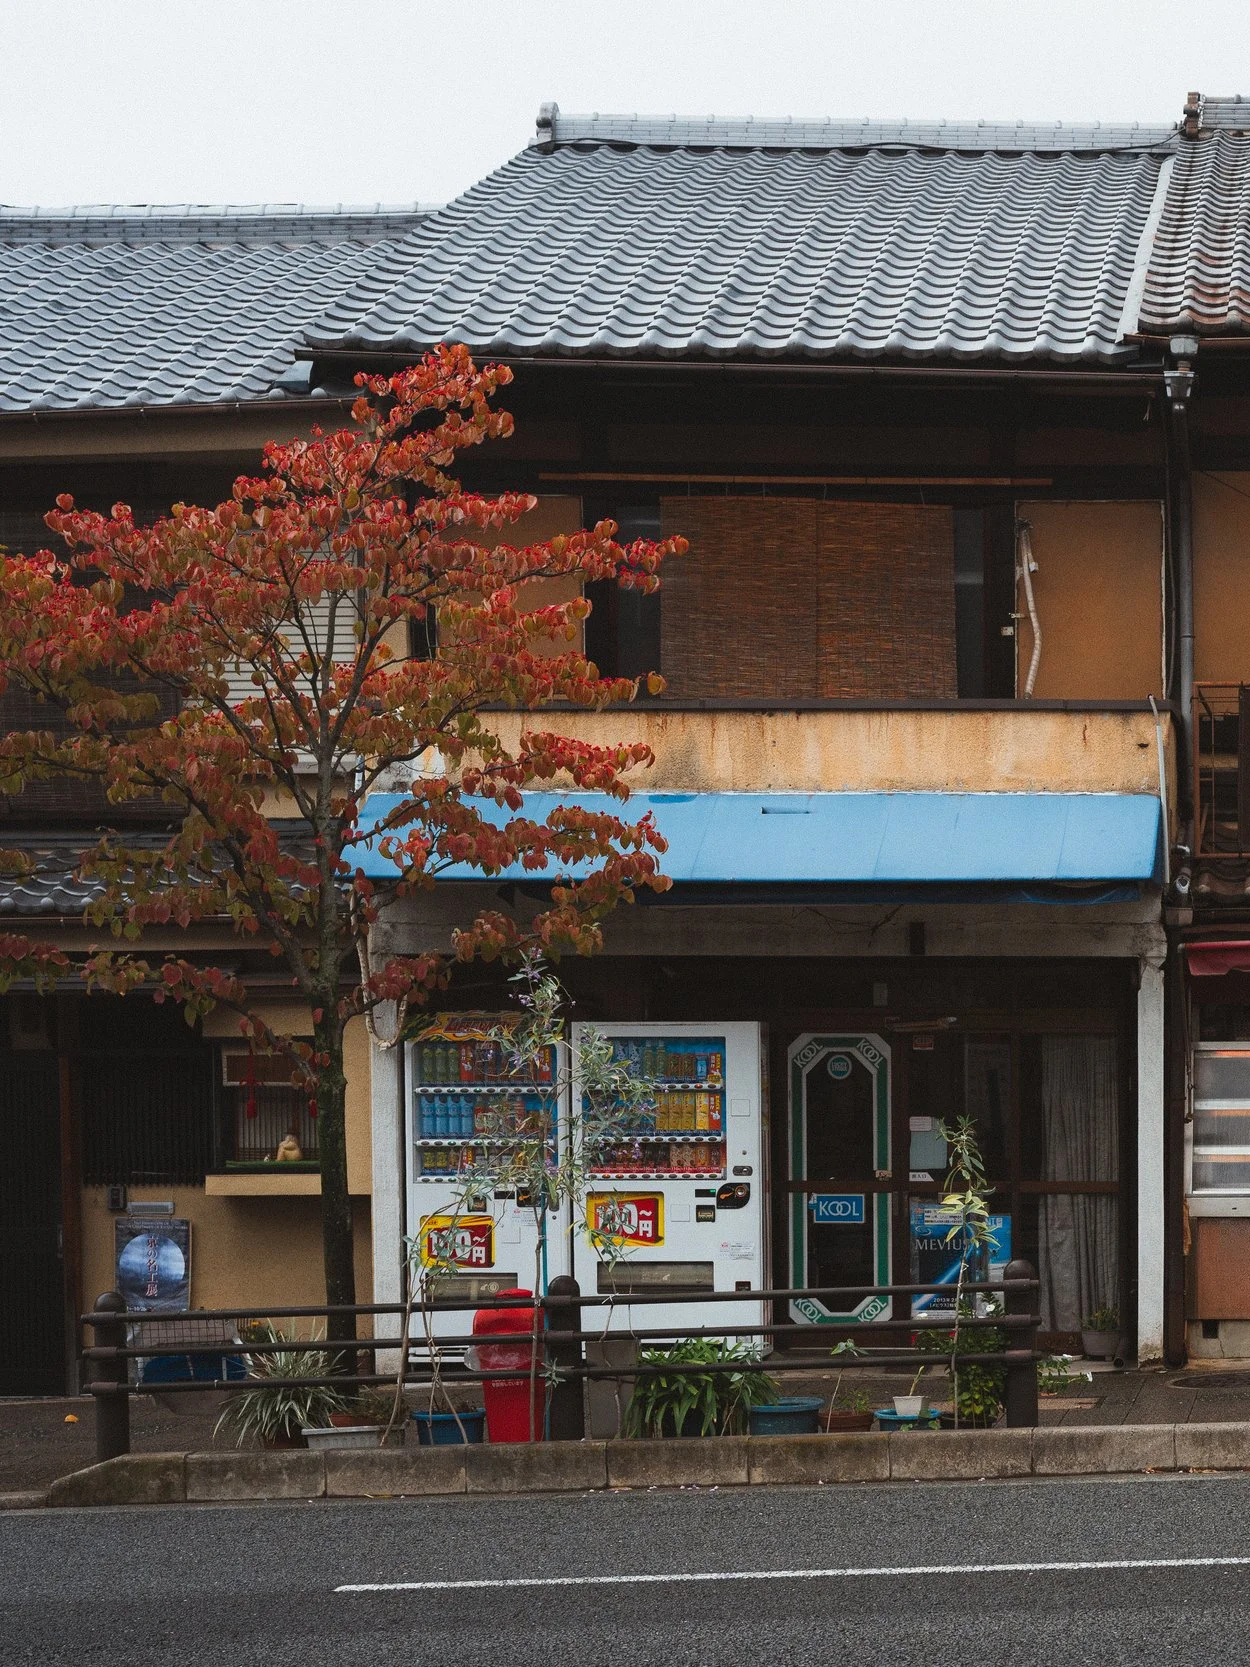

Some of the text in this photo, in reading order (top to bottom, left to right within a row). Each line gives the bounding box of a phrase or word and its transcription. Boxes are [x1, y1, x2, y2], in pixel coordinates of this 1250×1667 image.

[793, 1040, 824, 1068] KOOL
[856, 1038, 885, 1069] KOOL
[819, 1200, 860, 1216] KOOL
[145, 1235, 159, 1297] 京の名工展
[794, 1297, 822, 1324] KOOL
[858, 1298, 887, 1322] KOOL
